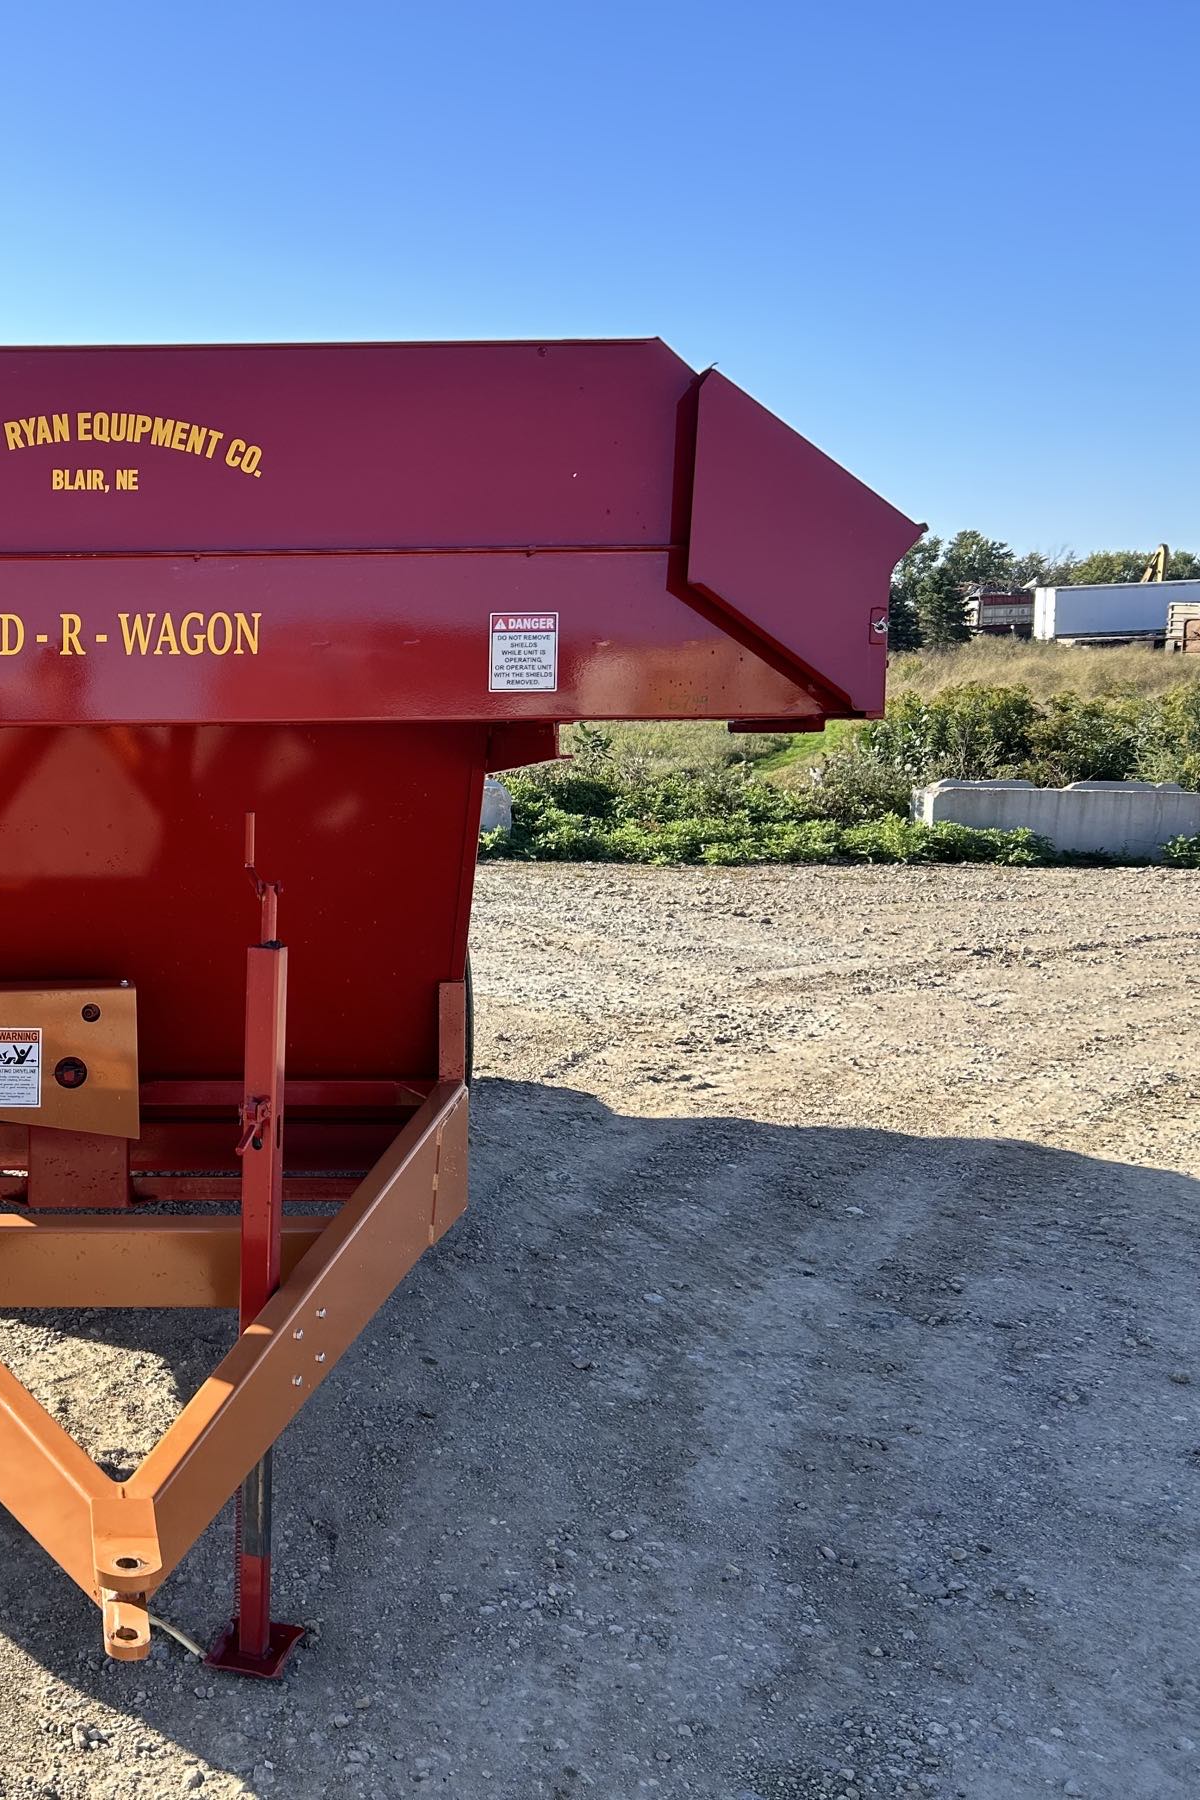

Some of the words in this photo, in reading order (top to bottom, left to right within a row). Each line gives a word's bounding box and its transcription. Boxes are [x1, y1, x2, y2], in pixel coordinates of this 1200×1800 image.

[3, 413, 70, 451] RYAN
[77, 411, 224, 459] EQUIPMENT
[224, 438, 263, 478] CO.
[52, 468, 110, 493] BLAIR,
[116, 469, 139, 491] NE
[59, 613, 86, 656] R
[117, 611, 262, 656] WAGON
[508, 618, 554, 629] DANGER
[0, 1032, 37, 1041] WARNING
